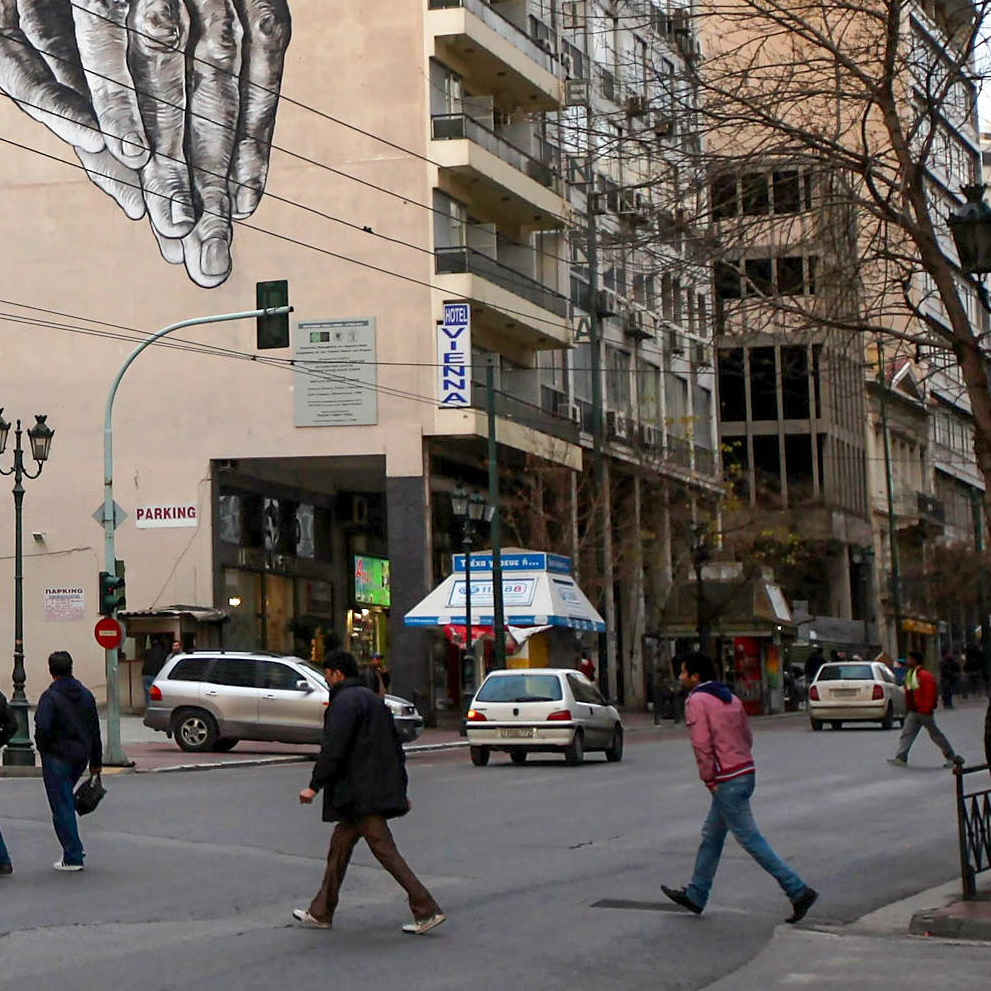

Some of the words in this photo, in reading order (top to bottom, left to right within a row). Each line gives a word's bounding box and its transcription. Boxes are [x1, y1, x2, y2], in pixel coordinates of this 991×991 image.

[444, 307, 468, 324] HOTEL
[441, 327, 468, 404] VIENNA
[136, 506, 196, 520] PARKING
[460, 558, 487, 568] Τέχα
[482, 585, 522, 594] 1188
